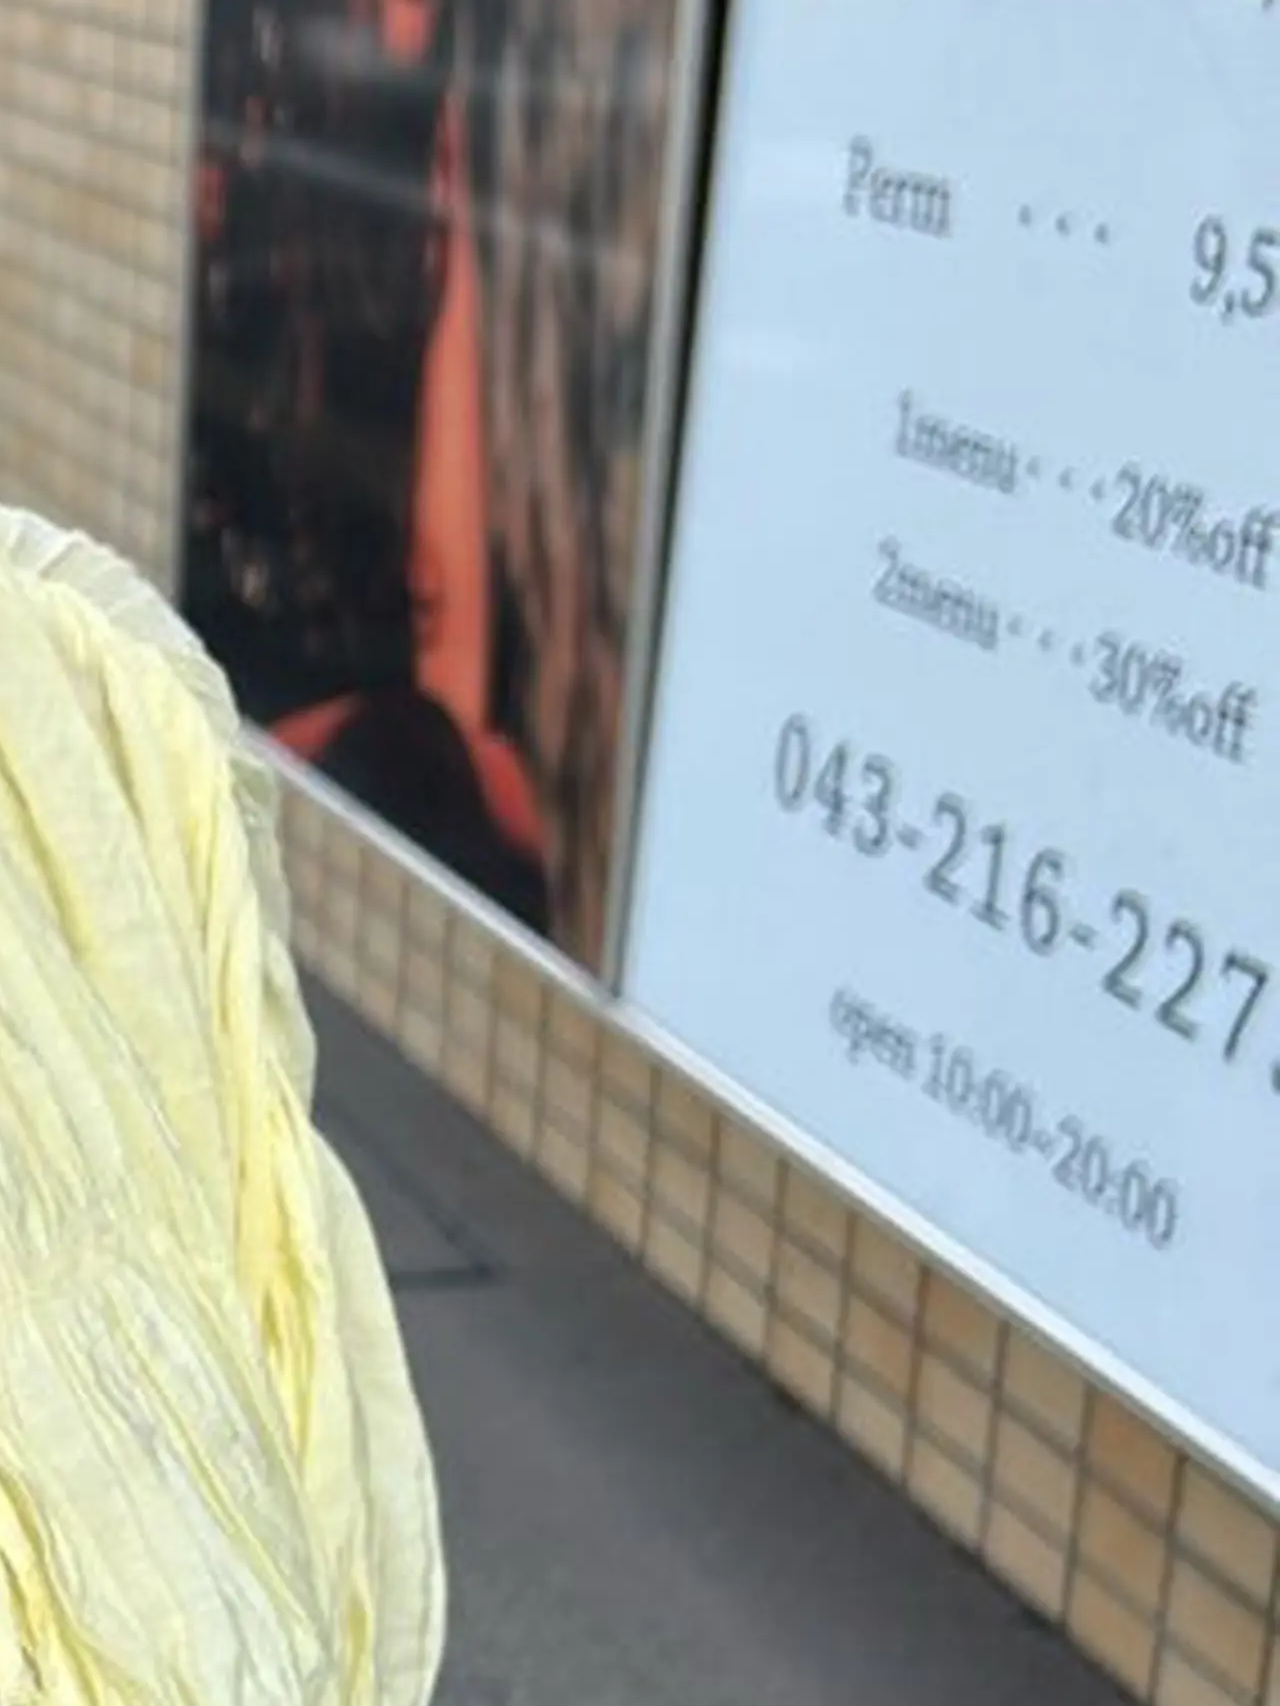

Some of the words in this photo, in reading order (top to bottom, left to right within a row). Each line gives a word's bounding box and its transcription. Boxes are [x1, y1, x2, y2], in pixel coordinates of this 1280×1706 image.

[842, 135, 950, 238] Perm
[775, 713, 1280, 1095] 043-216-227
[830, 987, 915, 1081] open
